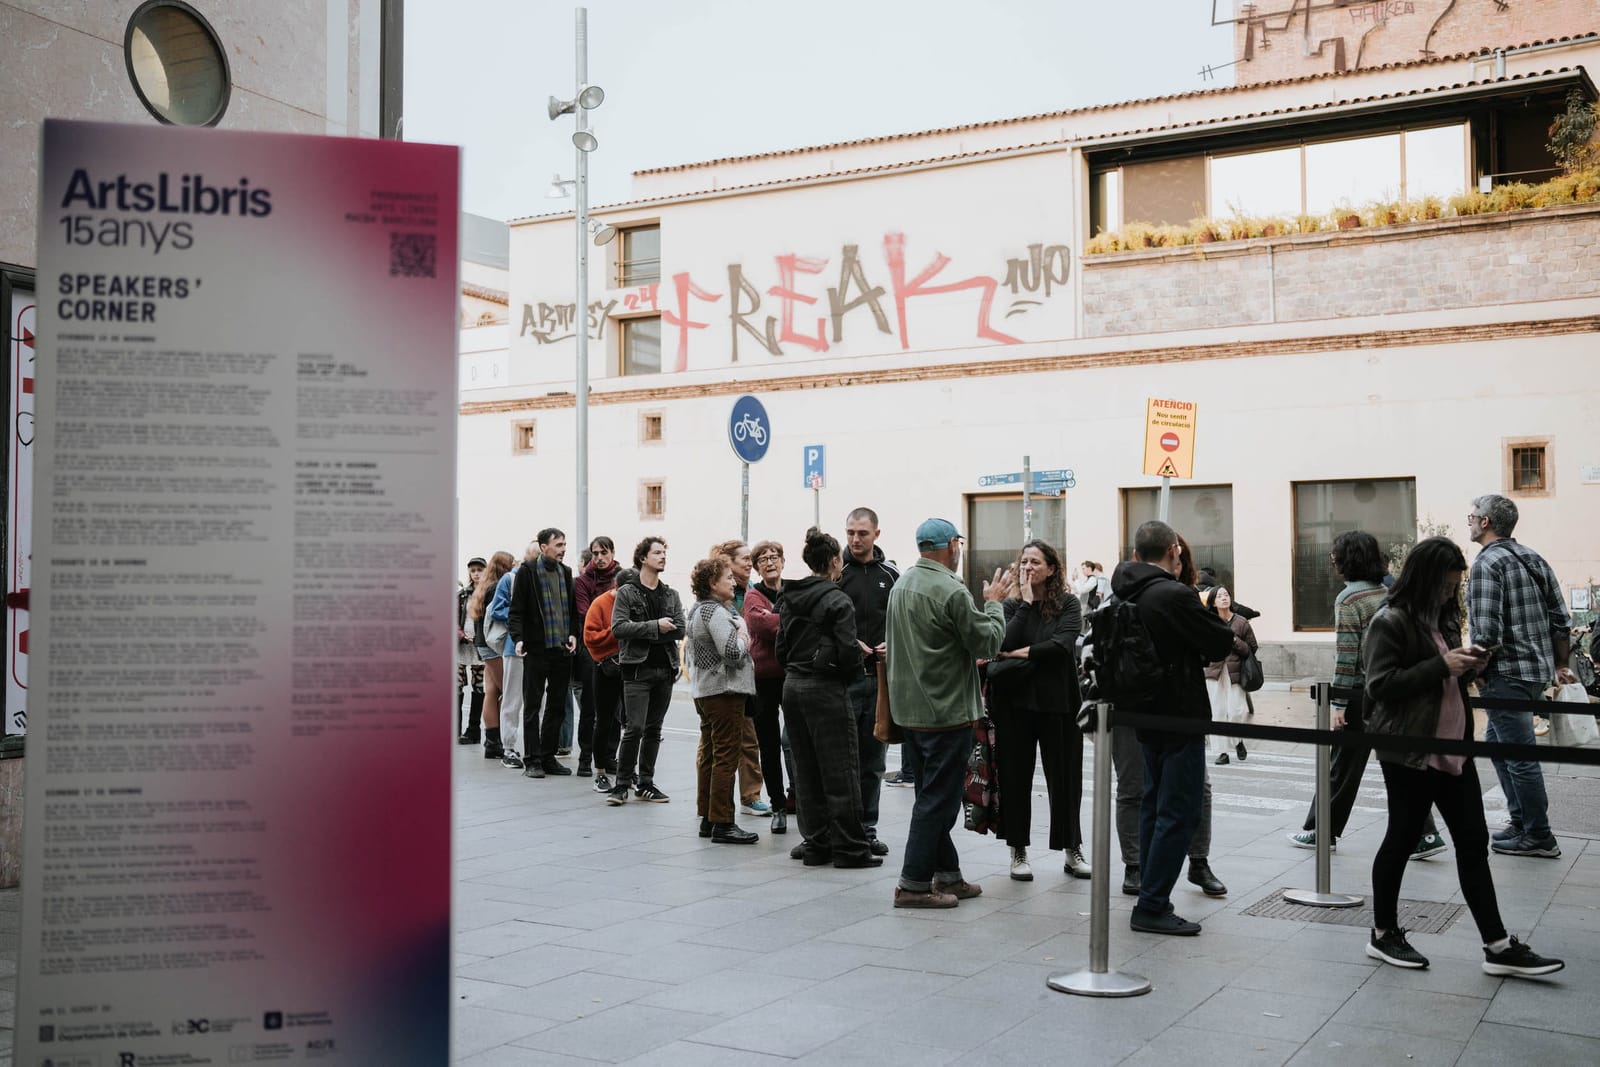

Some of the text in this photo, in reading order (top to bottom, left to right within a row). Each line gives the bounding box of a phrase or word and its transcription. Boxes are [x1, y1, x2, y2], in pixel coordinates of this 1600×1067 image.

[61, 168, 273, 217] ArtsLibris
[57, 299, 156, 323] CORNER
[661, 232, 1024, 372] FREAK
[808, 448, 819, 466] P
